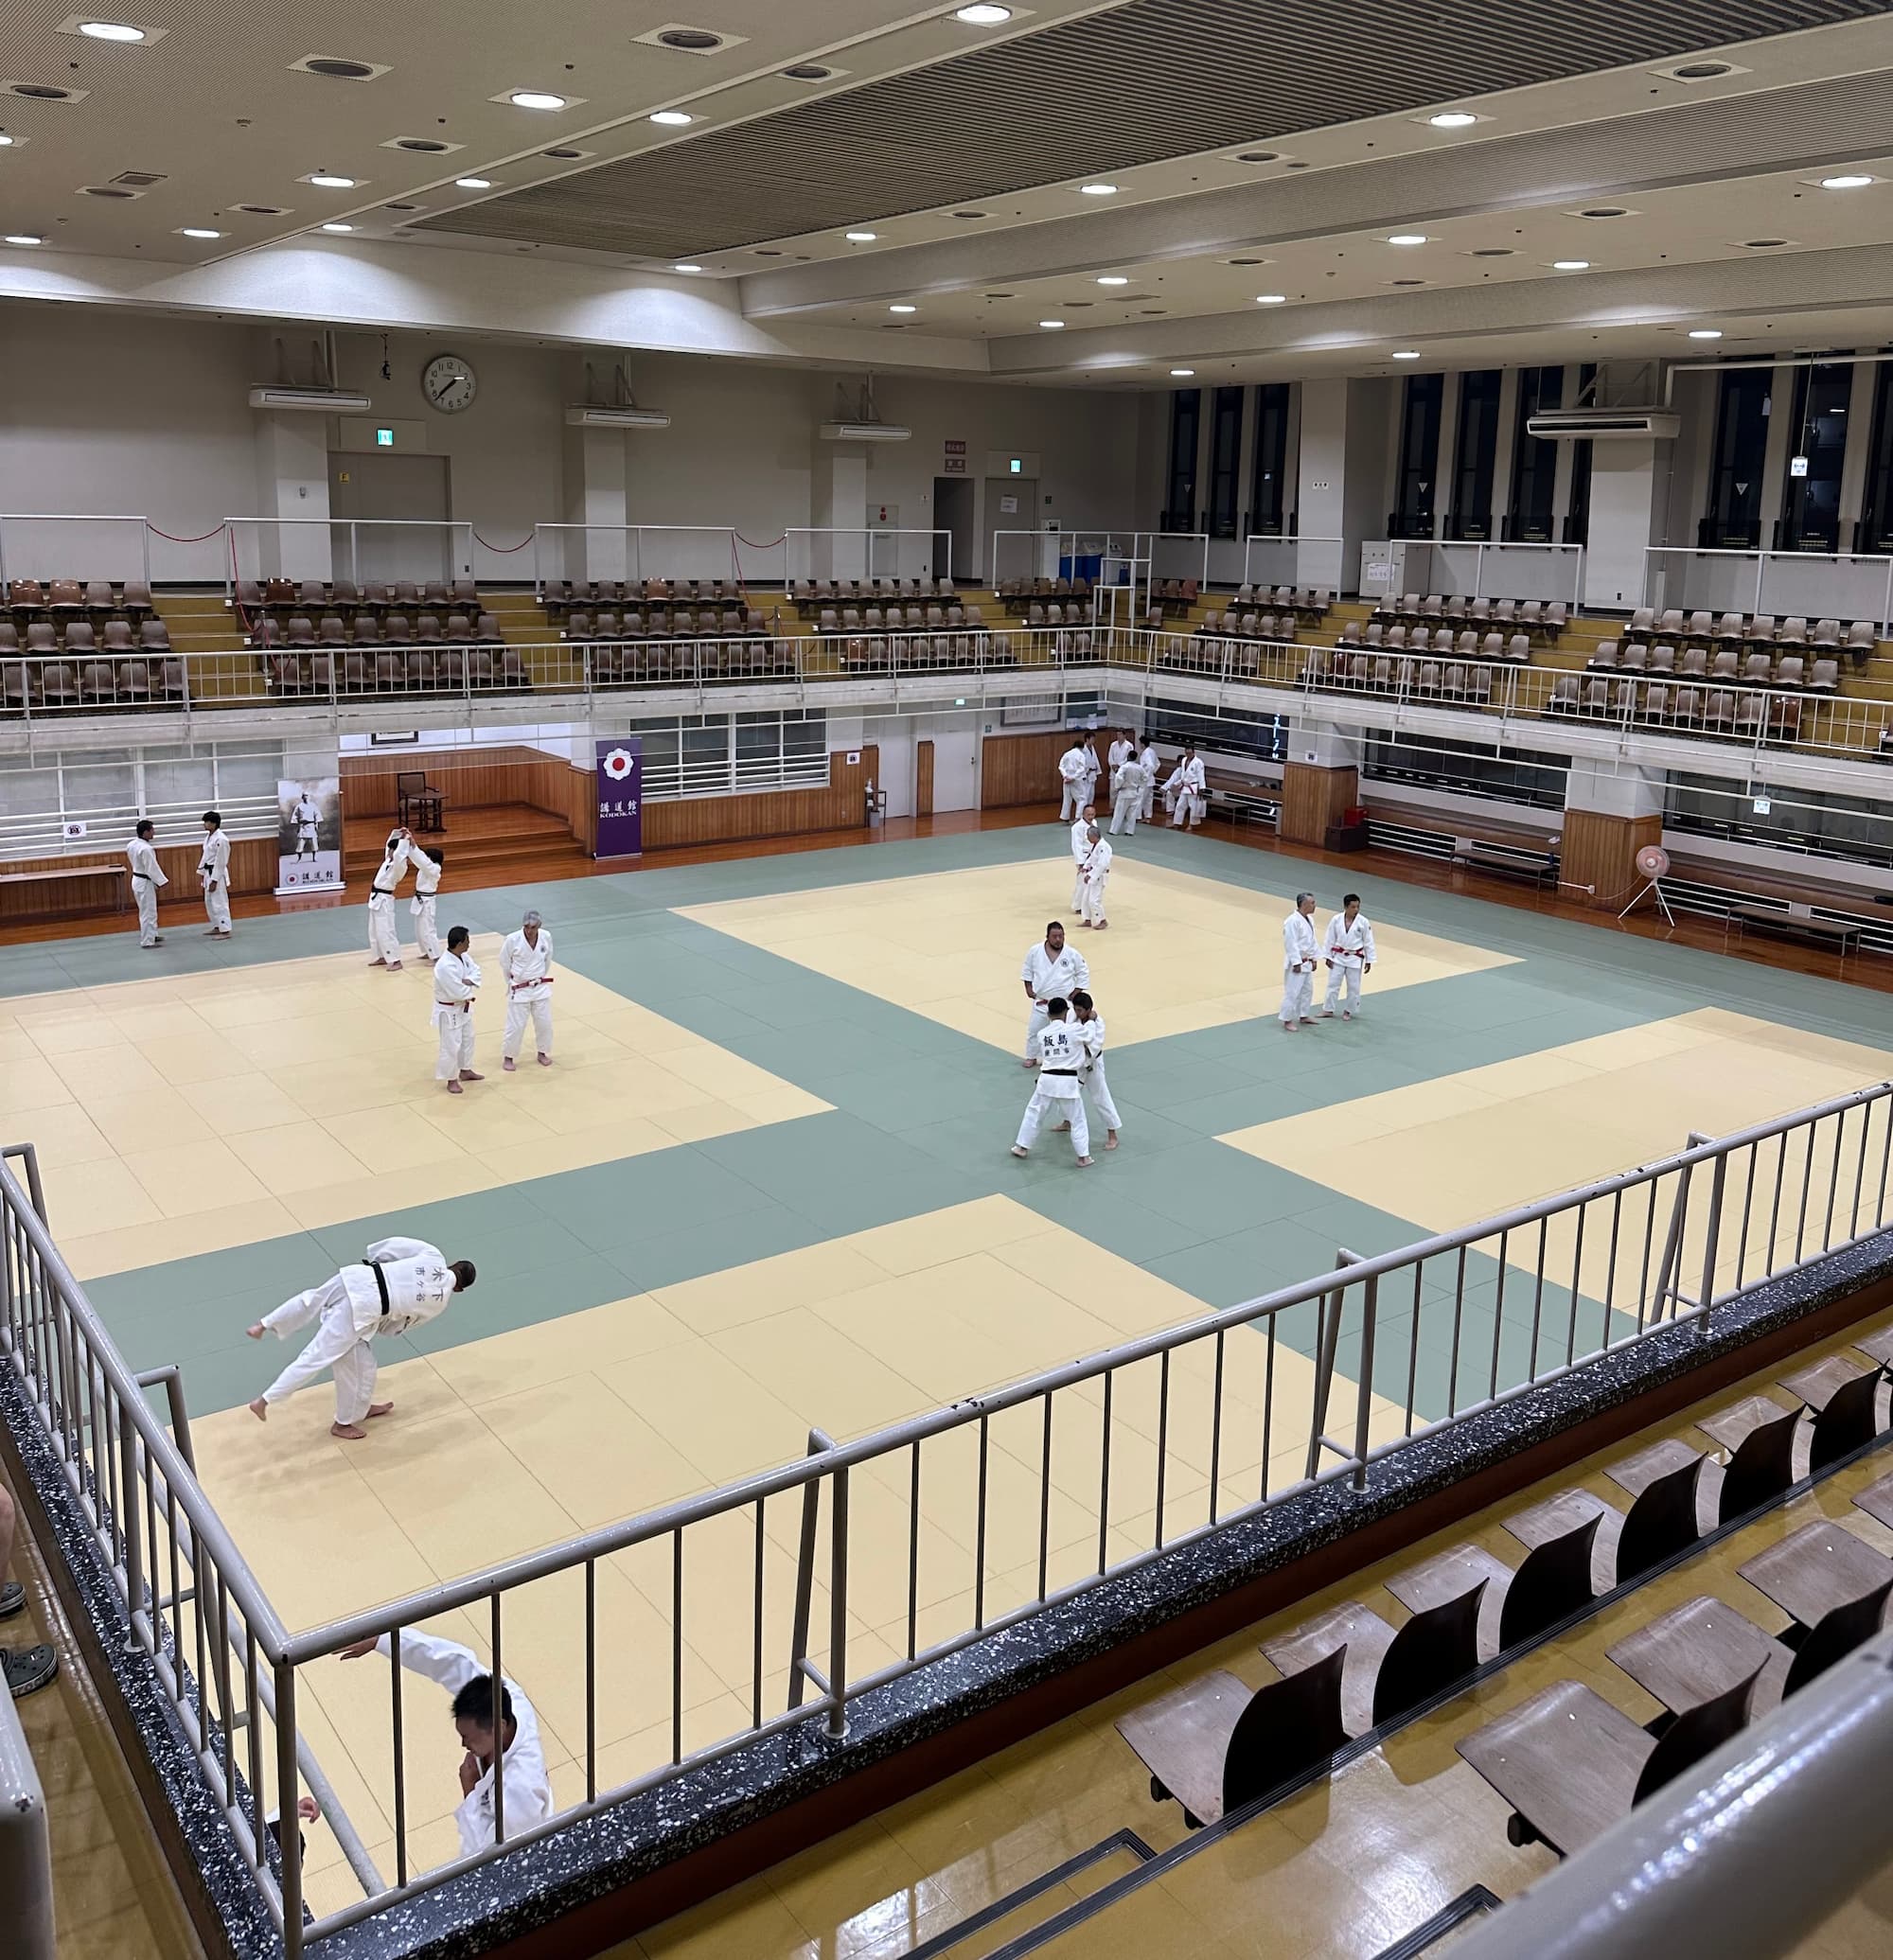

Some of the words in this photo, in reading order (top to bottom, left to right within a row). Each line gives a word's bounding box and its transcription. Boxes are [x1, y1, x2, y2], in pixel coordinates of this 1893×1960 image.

[438, 362, 444, 371] 11
[447, 362, 454, 370] 12
[457, 398, 463, 407] 5
[1043, 1033, 1068, 1047] 飯島
[432, 1267, 445, 1303] 木下
